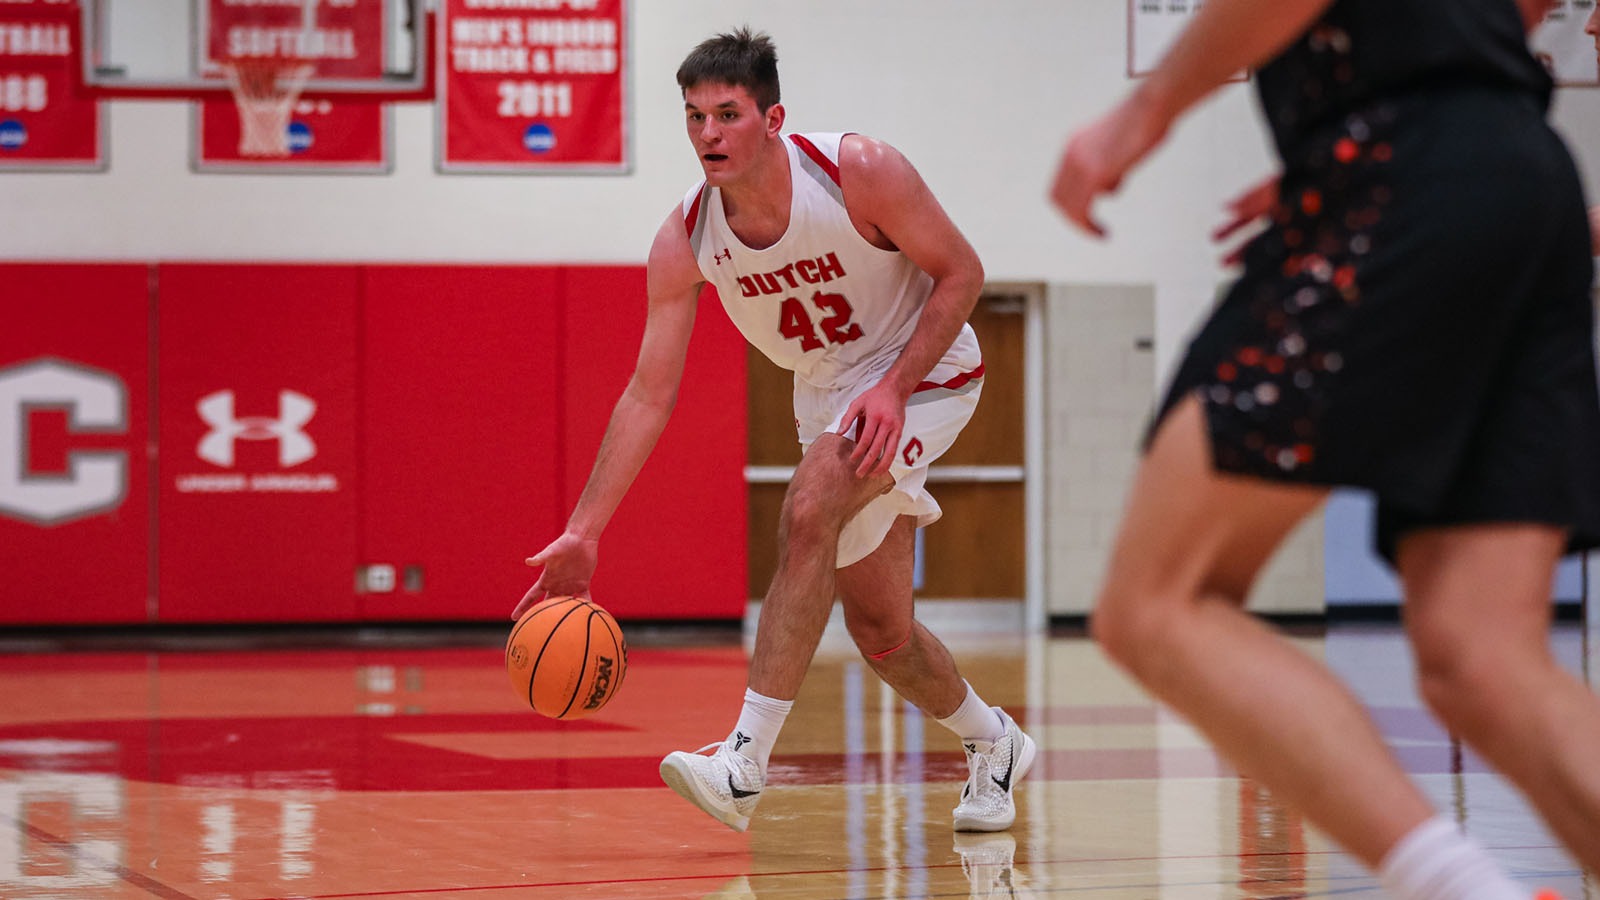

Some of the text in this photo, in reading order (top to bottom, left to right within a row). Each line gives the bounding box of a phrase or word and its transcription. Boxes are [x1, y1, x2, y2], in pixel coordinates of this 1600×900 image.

[453, 17, 617, 46] MEN'S INDOOR
[453, 46, 618, 74] TRACK & FIELD
[0, 73, 48, 111] 88
[497, 80, 573, 117] 2011
[736, 251, 846, 298] DUTCH
[778, 290, 865, 353] 42
[583, 655, 613, 710] NCAA
